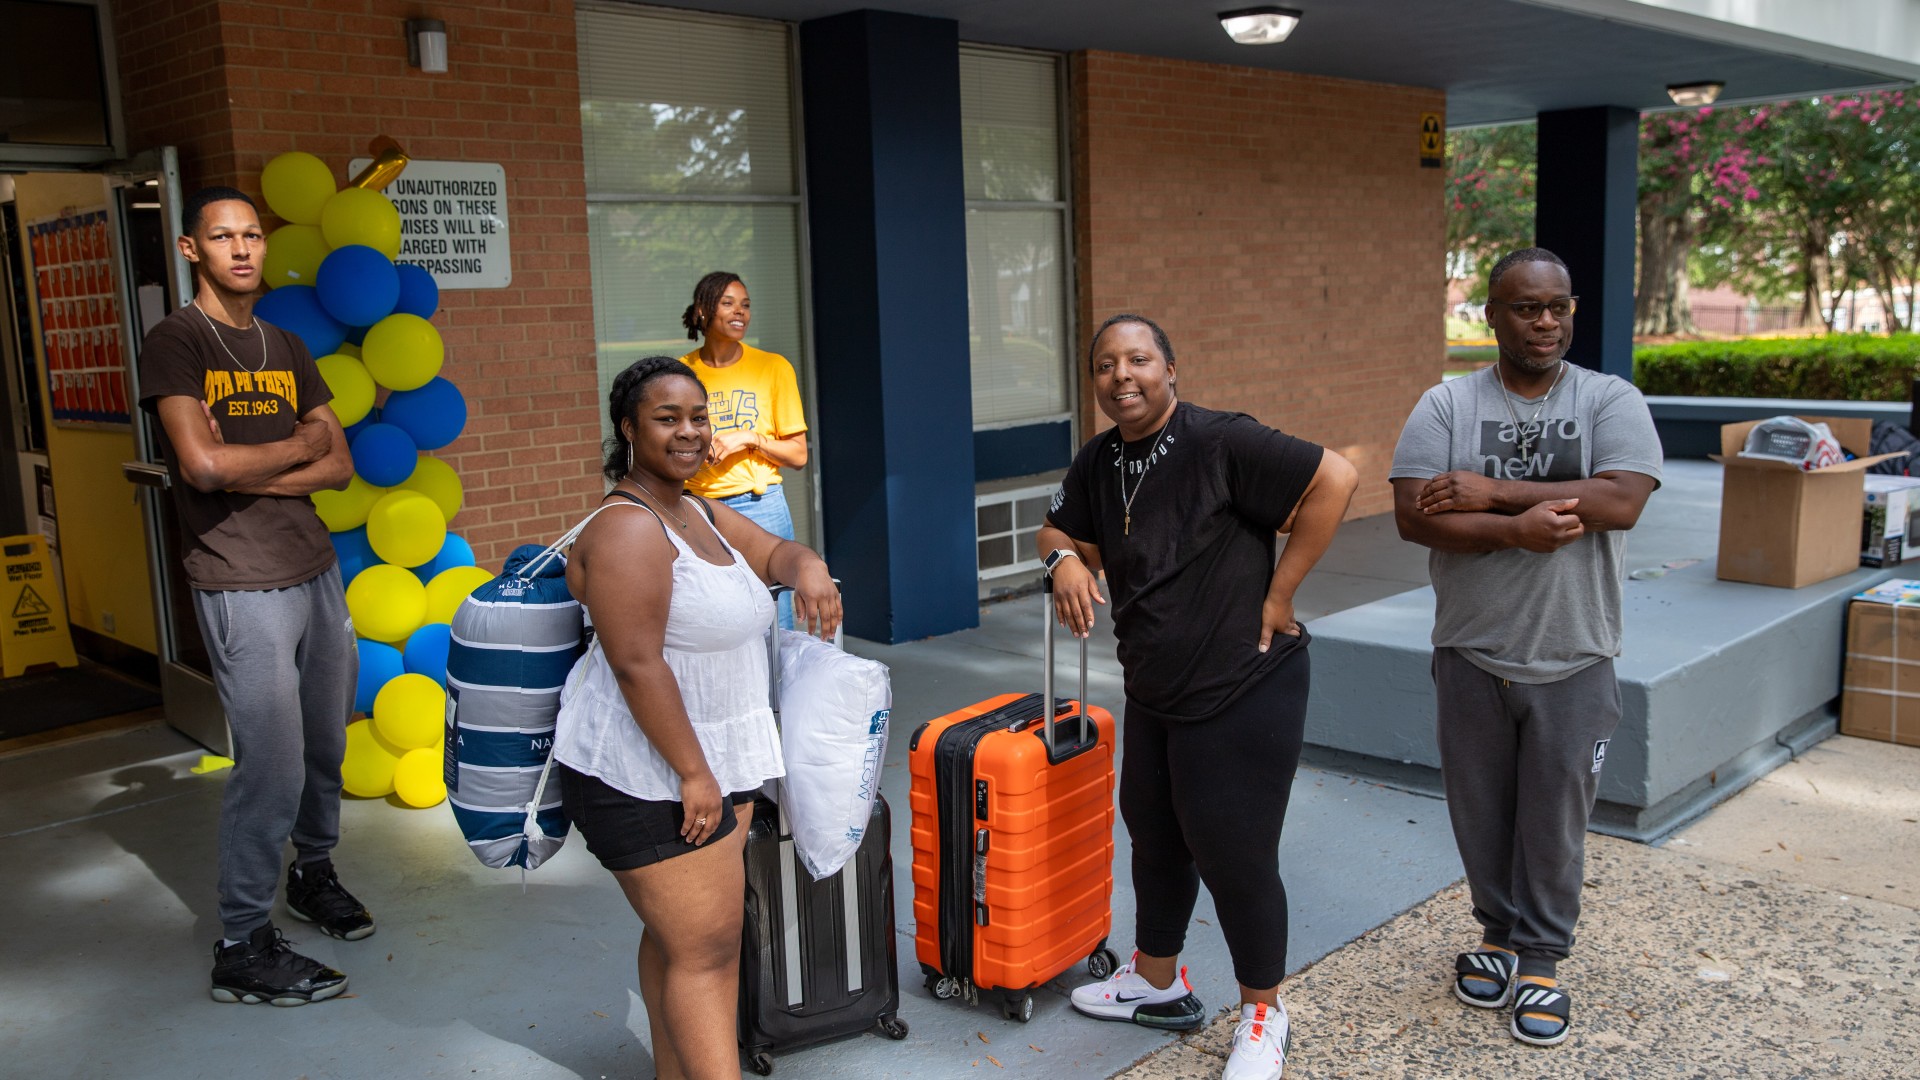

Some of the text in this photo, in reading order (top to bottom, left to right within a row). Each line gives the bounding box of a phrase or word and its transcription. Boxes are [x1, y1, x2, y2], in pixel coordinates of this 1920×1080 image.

[397, 180, 497, 196] UNAUTHORIZED
[391, 199, 497, 215] SONS ON THESE
[400, 219, 496, 234] MISES WILL BE
[399, 239, 486, 255] ARGED WITH
[1497, 417, 1582, 443] aero
[1480, 453, 1555, 481] new
[7, 563, 41, 574] CAUTION
[8, 572, 42, 582] Wet Floor
